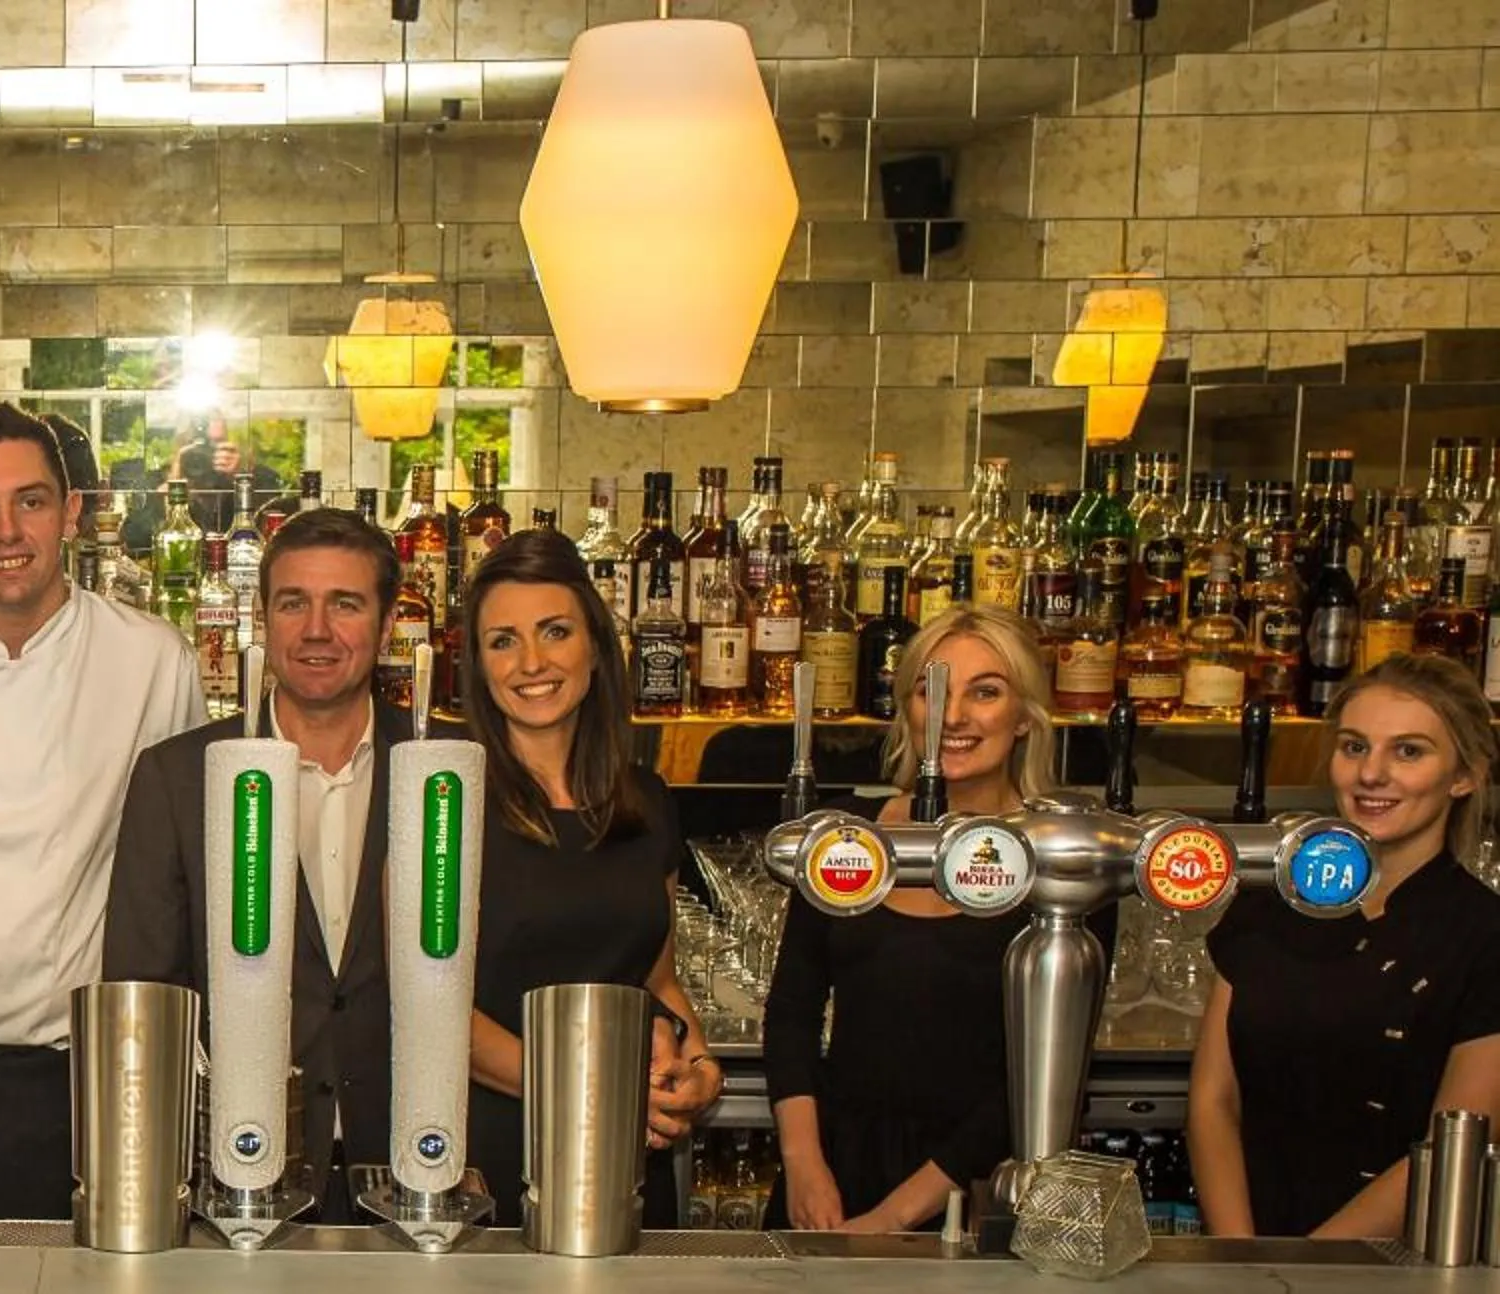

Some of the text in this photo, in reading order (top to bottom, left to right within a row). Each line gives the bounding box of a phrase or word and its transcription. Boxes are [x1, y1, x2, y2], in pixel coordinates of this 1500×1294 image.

[1046, 594, 1072, 610] 105
[245, 796, 259, 853] Heineken
[435, 798, 449, 855] Heineken
[824, 856, 871, 867] AMSTEL
[1155, 835, 1223, 869] CALEDONIAN
[247, 855, 256, 884] COLD
[437, 857, 446, 886] COLD
[834, 871, 858, 880] BIER
[955, 871, 1016, 887] MORETTI
[247, 886, 255, 921] EXTRA
[1157, 880, 1216, 900] BREWERY
[436, 888, 444, 924] EXTRA
